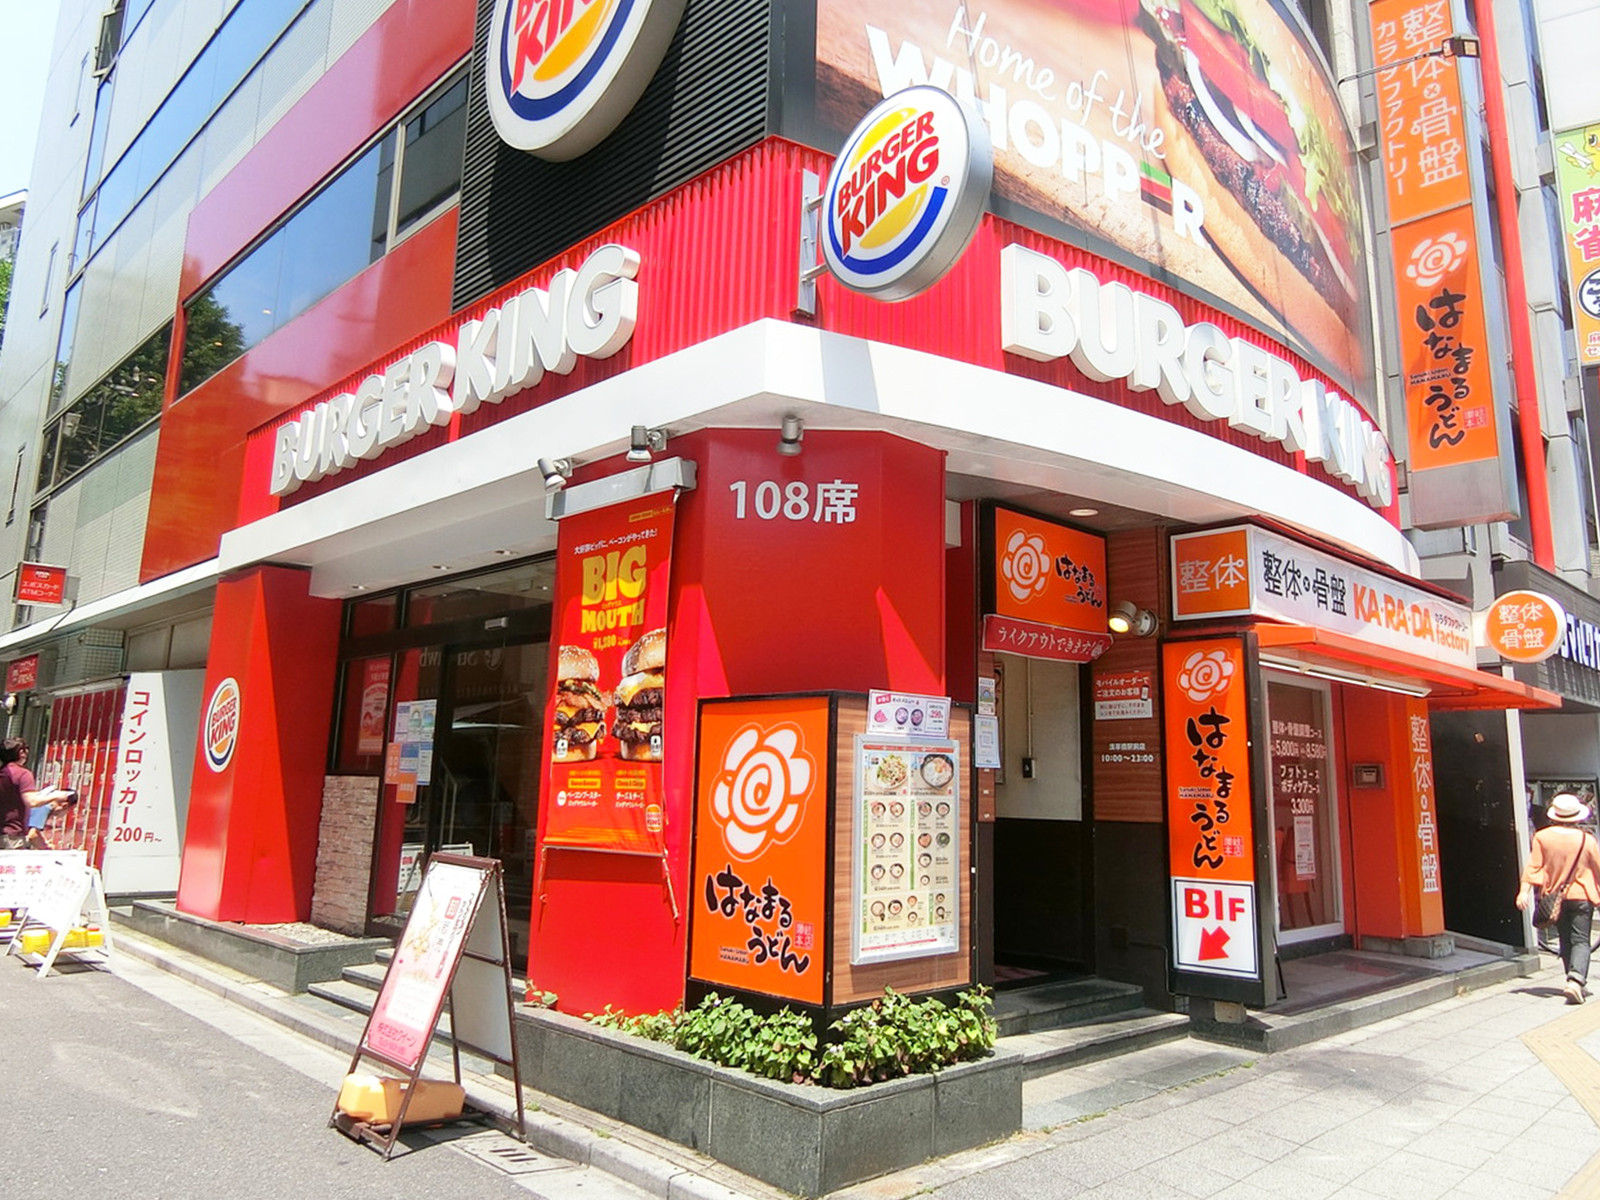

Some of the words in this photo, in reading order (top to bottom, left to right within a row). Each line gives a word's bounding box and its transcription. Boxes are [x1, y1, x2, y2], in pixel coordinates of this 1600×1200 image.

[947, 4, 1055, 100] Home
[1066, 70, 1108, 121] of
[1109, 81, 1166, 160] the
[1376, 20, 1408, 196] カラダファクトリー
[838, 110, 934, 215] BURGER
[841, 136, 940, 258] KING
[270, 341, 456, 496] BURGER
[452, 244, 641, 415] KING
[1415, 288, 1475, 400] はなまる
[1001, 243, 1307, 453] BURGER
[1300, 377, 1392, 509] KING
[1424, 385, 1465, 449] うどん
[730, 480, 859, 524] 108席
[582, 544, 647, 606] BIG
[1056, 554, 1095, 588] はなまる
[1077, 586, 1103, 608] うどん
[1179, 554, 1247, 594] 整体
[581, 598, 646, 634] MOUTH
[1436, 623, 1470, 656] factory
[1498, 602, 1545, 625] 整体
[1499, 628, 1545, 650] 骨盤
[210, 711, 236, 748] KING
[211, 697, 237, 727] BURGER
[118, 691, 151, 824] コインロッカー
[1187, 706, 1235, 824] はなまる
[1280, 764, 1320, 779] フットコース
[1191, 803, 1224, 870] うどん
[705, 863, 793, 929] はなまる
[747, 926, 810, 974] うどん
